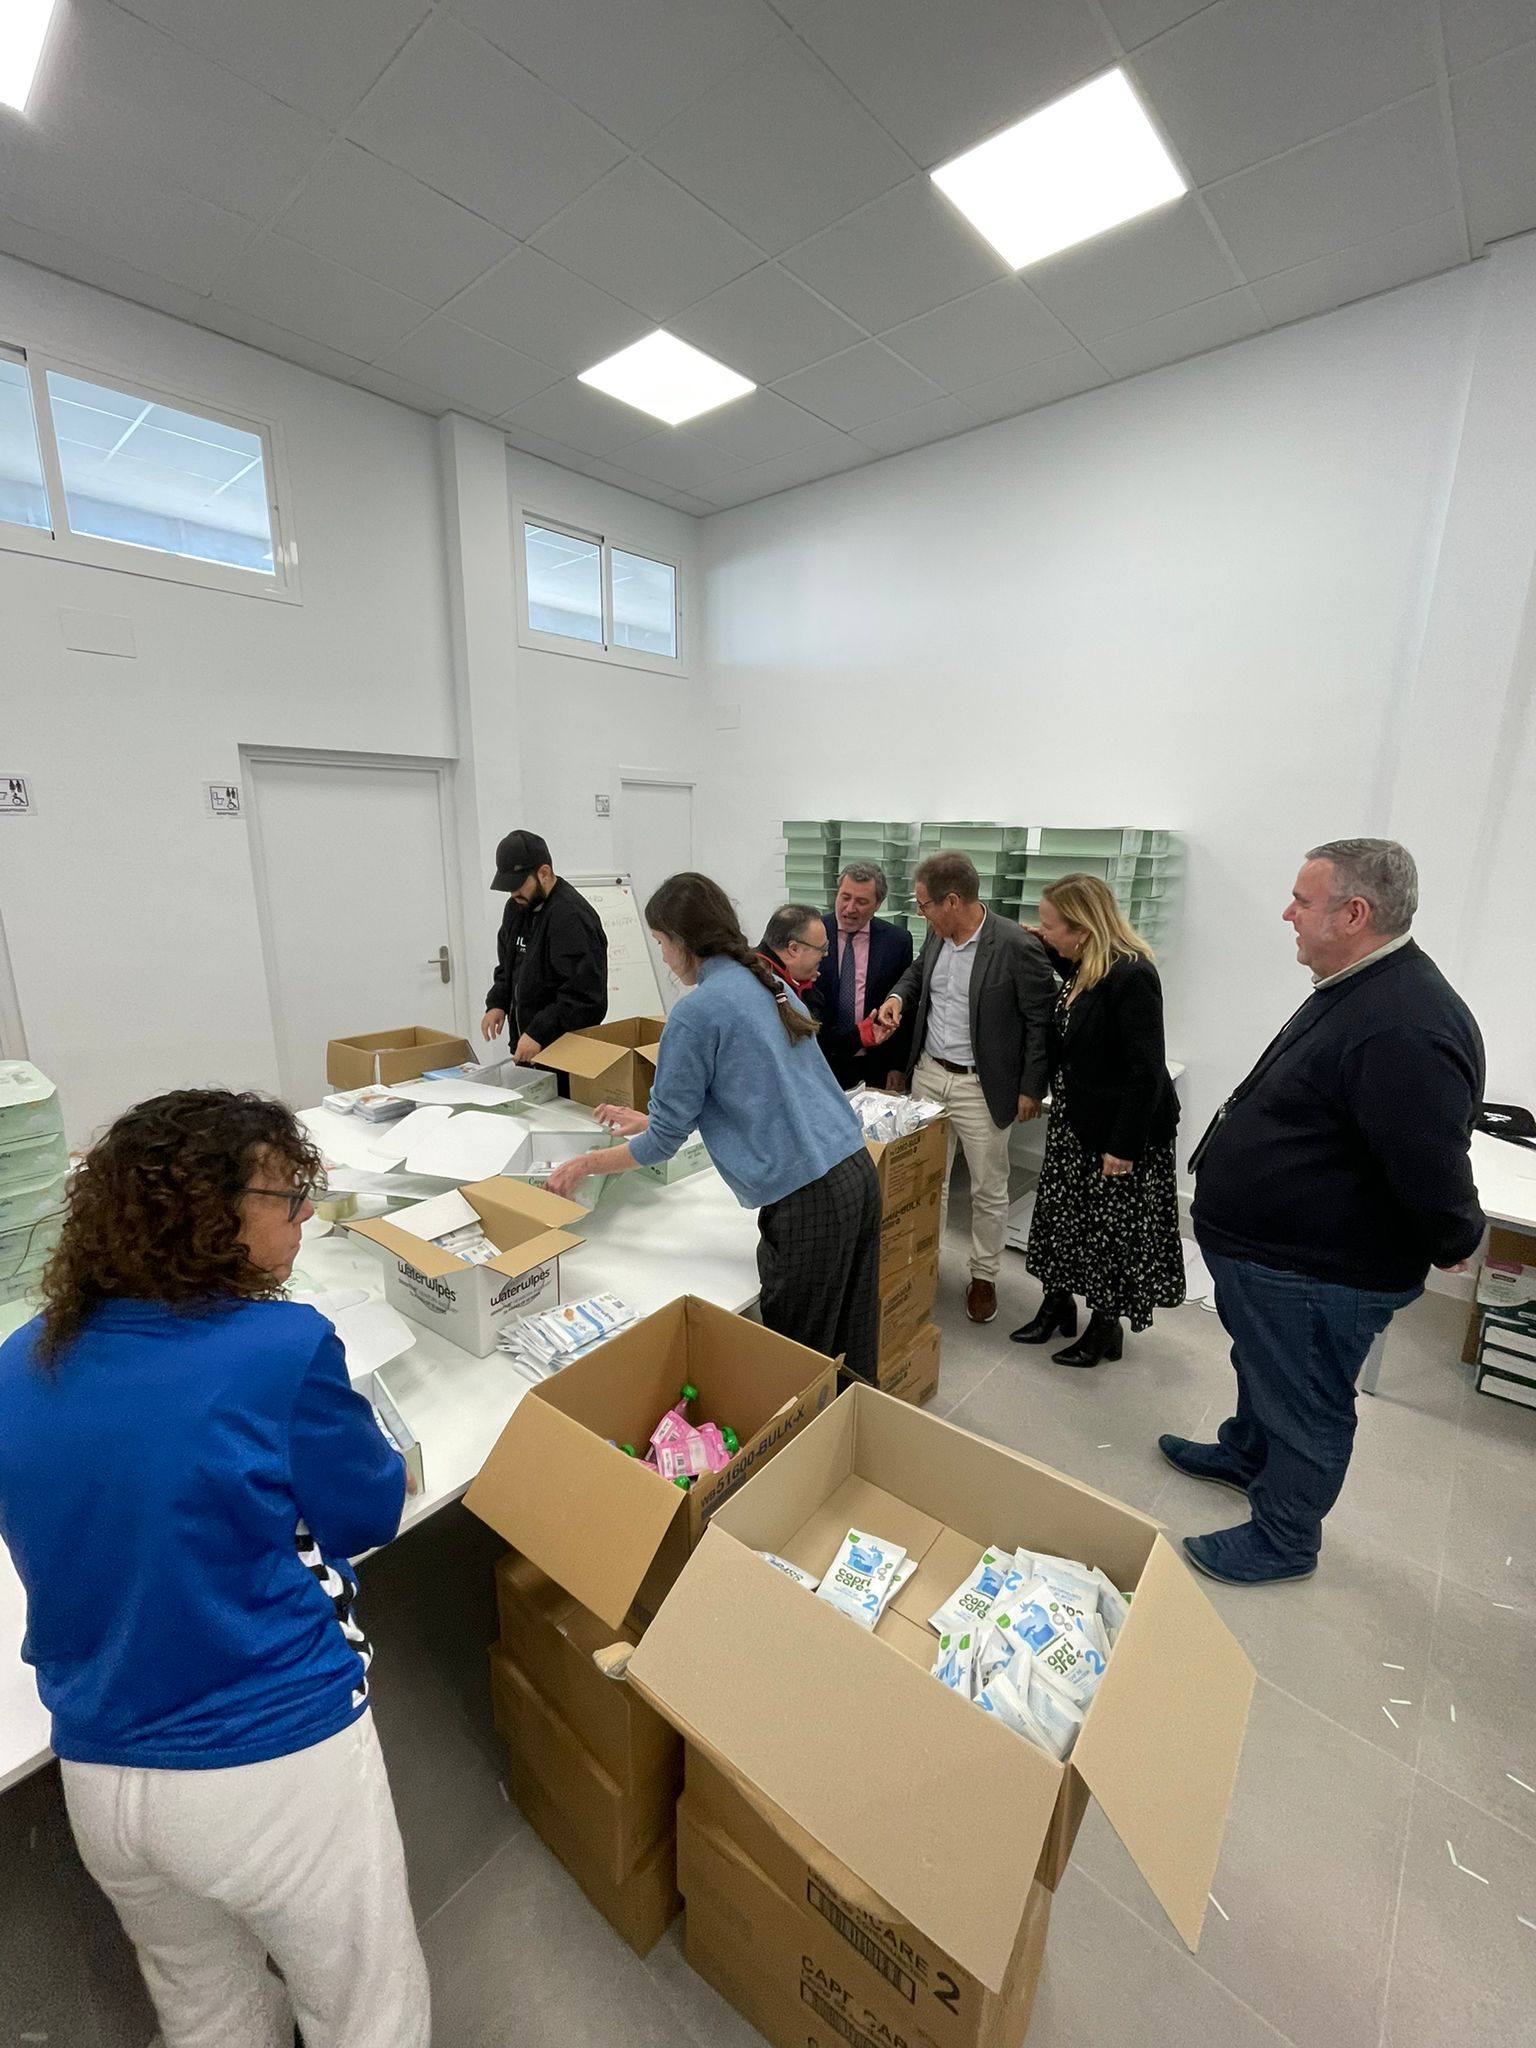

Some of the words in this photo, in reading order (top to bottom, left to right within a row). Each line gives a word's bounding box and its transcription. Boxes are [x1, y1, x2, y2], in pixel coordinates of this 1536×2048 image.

[838, 1567, 872, 1587] capri
[835, 1573, 865, 1592] care
[862, 1593, 879, 1612] 2
[964, 1593, 991, 1611] capr
[958, 1598, 986, 1619] care
[1044, 1638, 1074, 1666] apri
[1054, 1654, 1077, 1675] are
[1084, 1649, 1106, 1676] 2
[933, 1971, 961, 2016] 2
